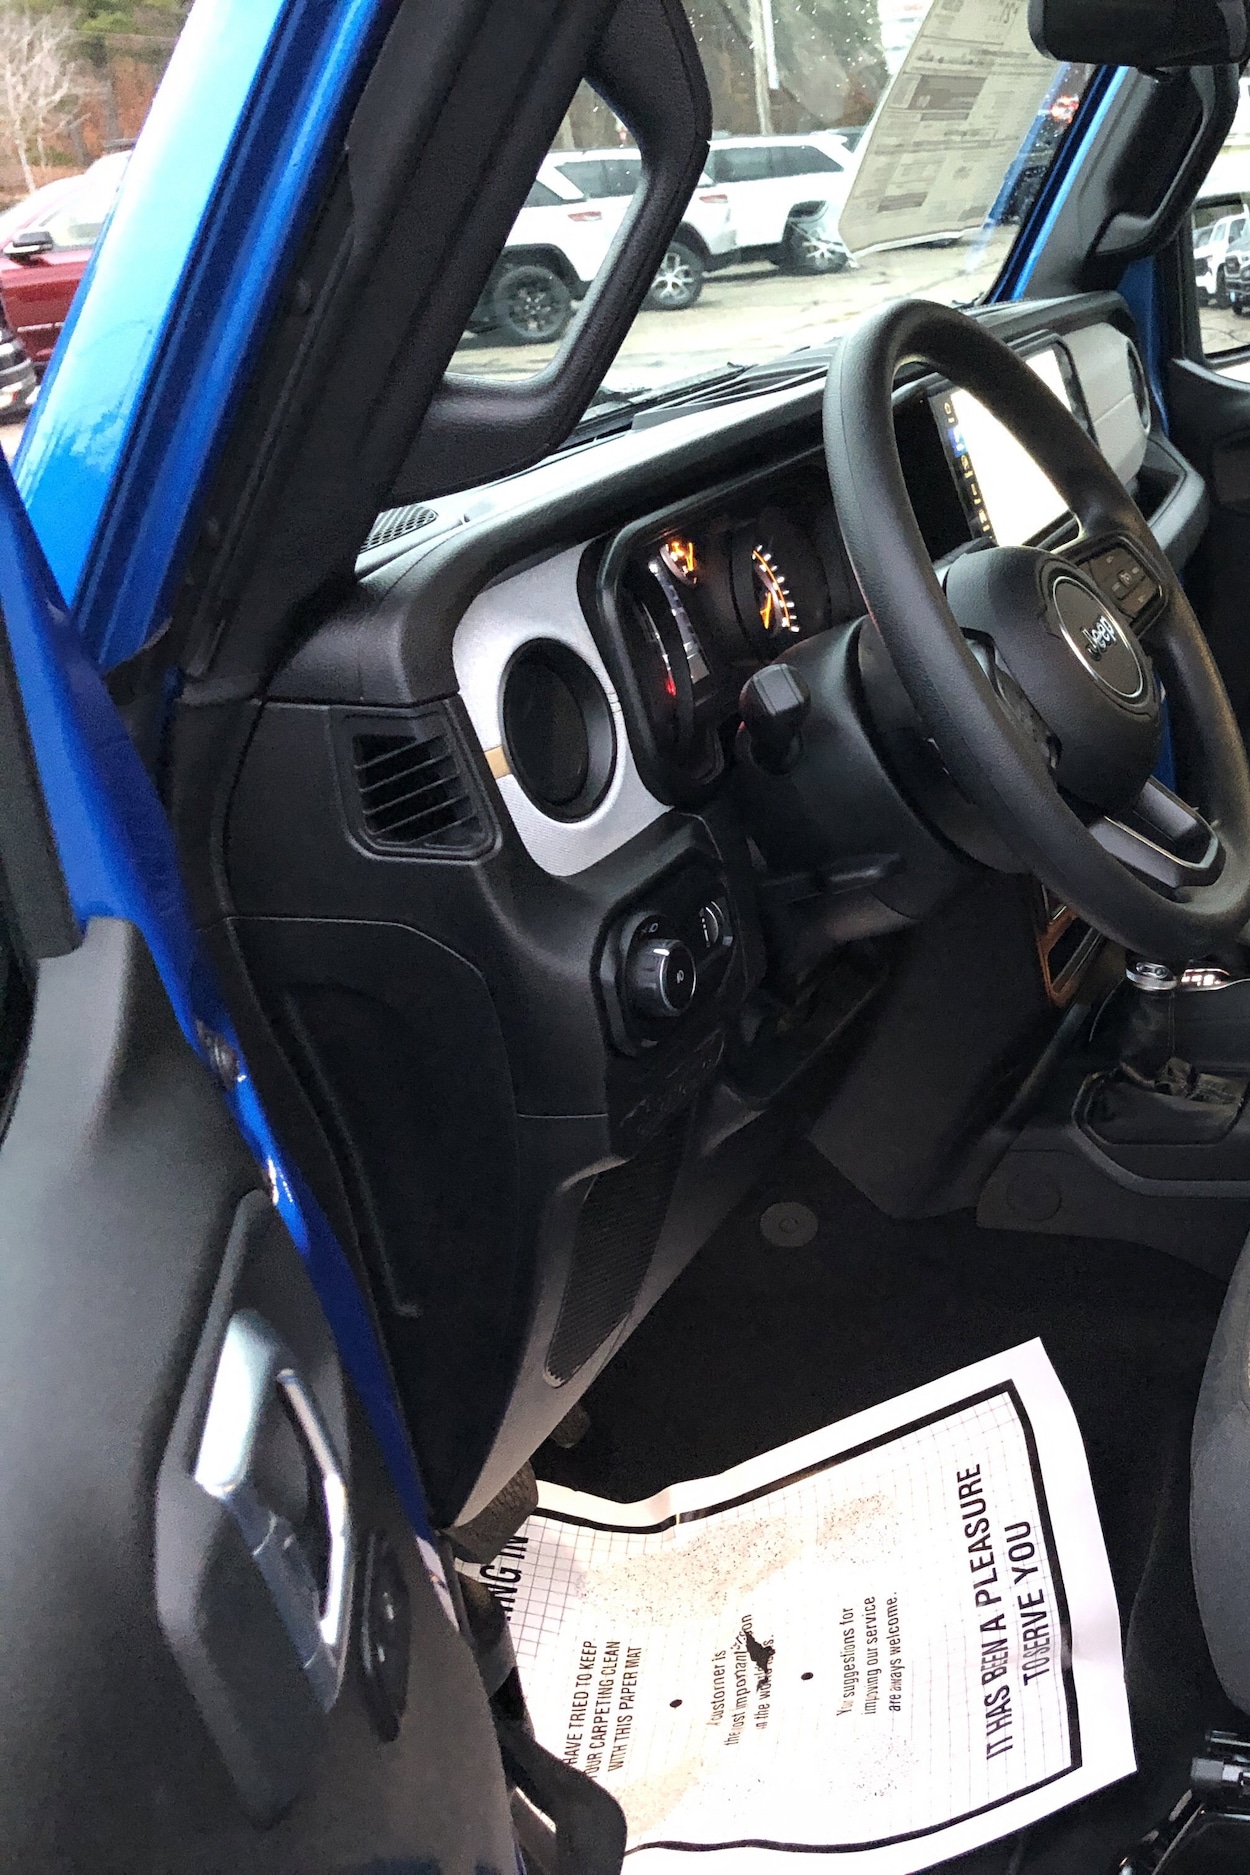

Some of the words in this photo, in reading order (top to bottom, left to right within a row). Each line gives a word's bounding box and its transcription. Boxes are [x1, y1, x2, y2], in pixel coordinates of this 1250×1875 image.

[1081, 616, 1117, 660] Jeep
[956, 1463, 1002, 1609] PLEASURE
[1004, 1521, 1039, 1585] YOU
[839, 1608, 854, 1625] for
[861, 1596, 878, 1645] service
[886, 1591, 902, 1656] welcome.
[979, 1613, 1007, 1633] A
[1016, 1588, 1051, 1658] SERVE
[579, 1641, 597, 1670] KEEP
[601, 1641, 620, 1675] CLEAN
[624, 1646, 642, 1668] MAT
[711, 1650, 726, 1662] is
[840, 1627, 859, 1698] suggestions
[865, 1647, 878, 1666] our
[980, 1638, 1009, 1686] BEEN
[575, 1673, 592, 1687] TO
[619, 1672, 638, 1710] PAPER
[568, 1691, 589, 1729] TRIED
[589, 1679, 614, 1749] CARPETING
[753, 1703, 770, 1719] the
[888, 1694, 901, 1712] are
[983, 1684, 1013, 1737] HAS
[614, 1715, 633, 1743] THIS
[723, 1731, 741, 1746] the
[561, 1733, 583, 1765] HAVE
[608, 1744, 627, 1772] WITH
[986, 1736, 1013, 1760] IT
